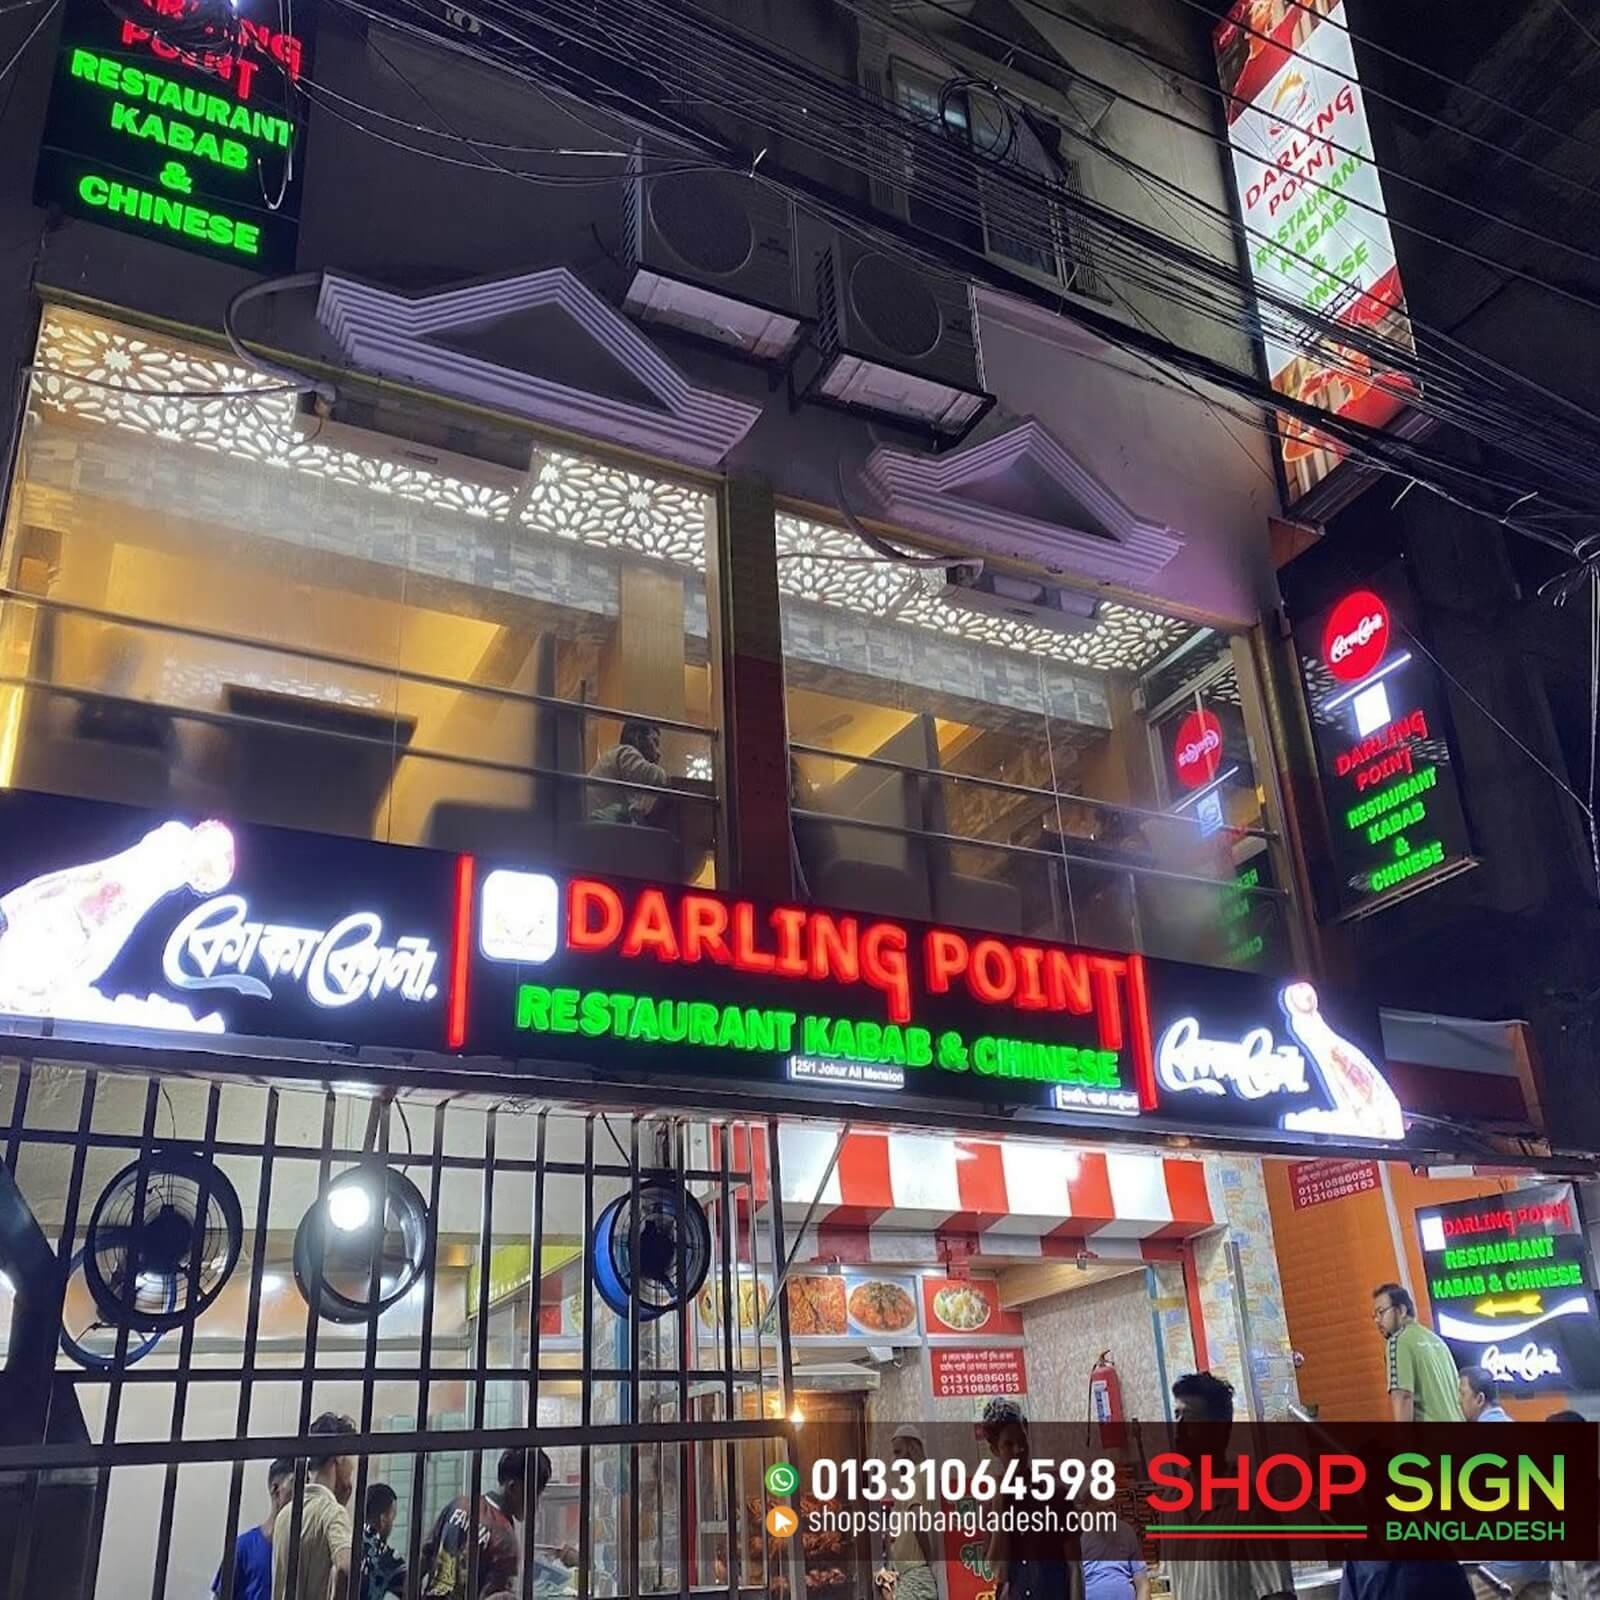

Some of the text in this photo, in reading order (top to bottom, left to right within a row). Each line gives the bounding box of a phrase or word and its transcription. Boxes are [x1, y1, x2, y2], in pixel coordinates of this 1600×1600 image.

[70, 48, 291, 147] RESTAURANT
[110, 101, 248, 169] KABAB
[1244, 84, 1355, 210] DARLING
[159, 160, 193, 194] &
[1268, 135, 1336, 217] POINT
[78, 175, 260, 254] CHINESE
[1335, 710, 1428, 777] DARLING
[1355, 747, 1414, 791] POINT
[1348, 766, 1438, 829] RESTAURANT
[1367, 801, 1426, 844] KABAB
[1371, 841, 1445, 892] CHINESE
[1395, 836, 1410, 857] &
[566, 877, 1129, 1051] DARLING POINT
[516, 983, 1122, 1089] RESTAURANT KABAB & CHINESE
[1443, 1202, 1572, 1237] DARLING POINT
[1432, 1263, 1583, 1299] KABAB & CHINESE
[1444, 1237, 1555, 1270] RESTAURANT
